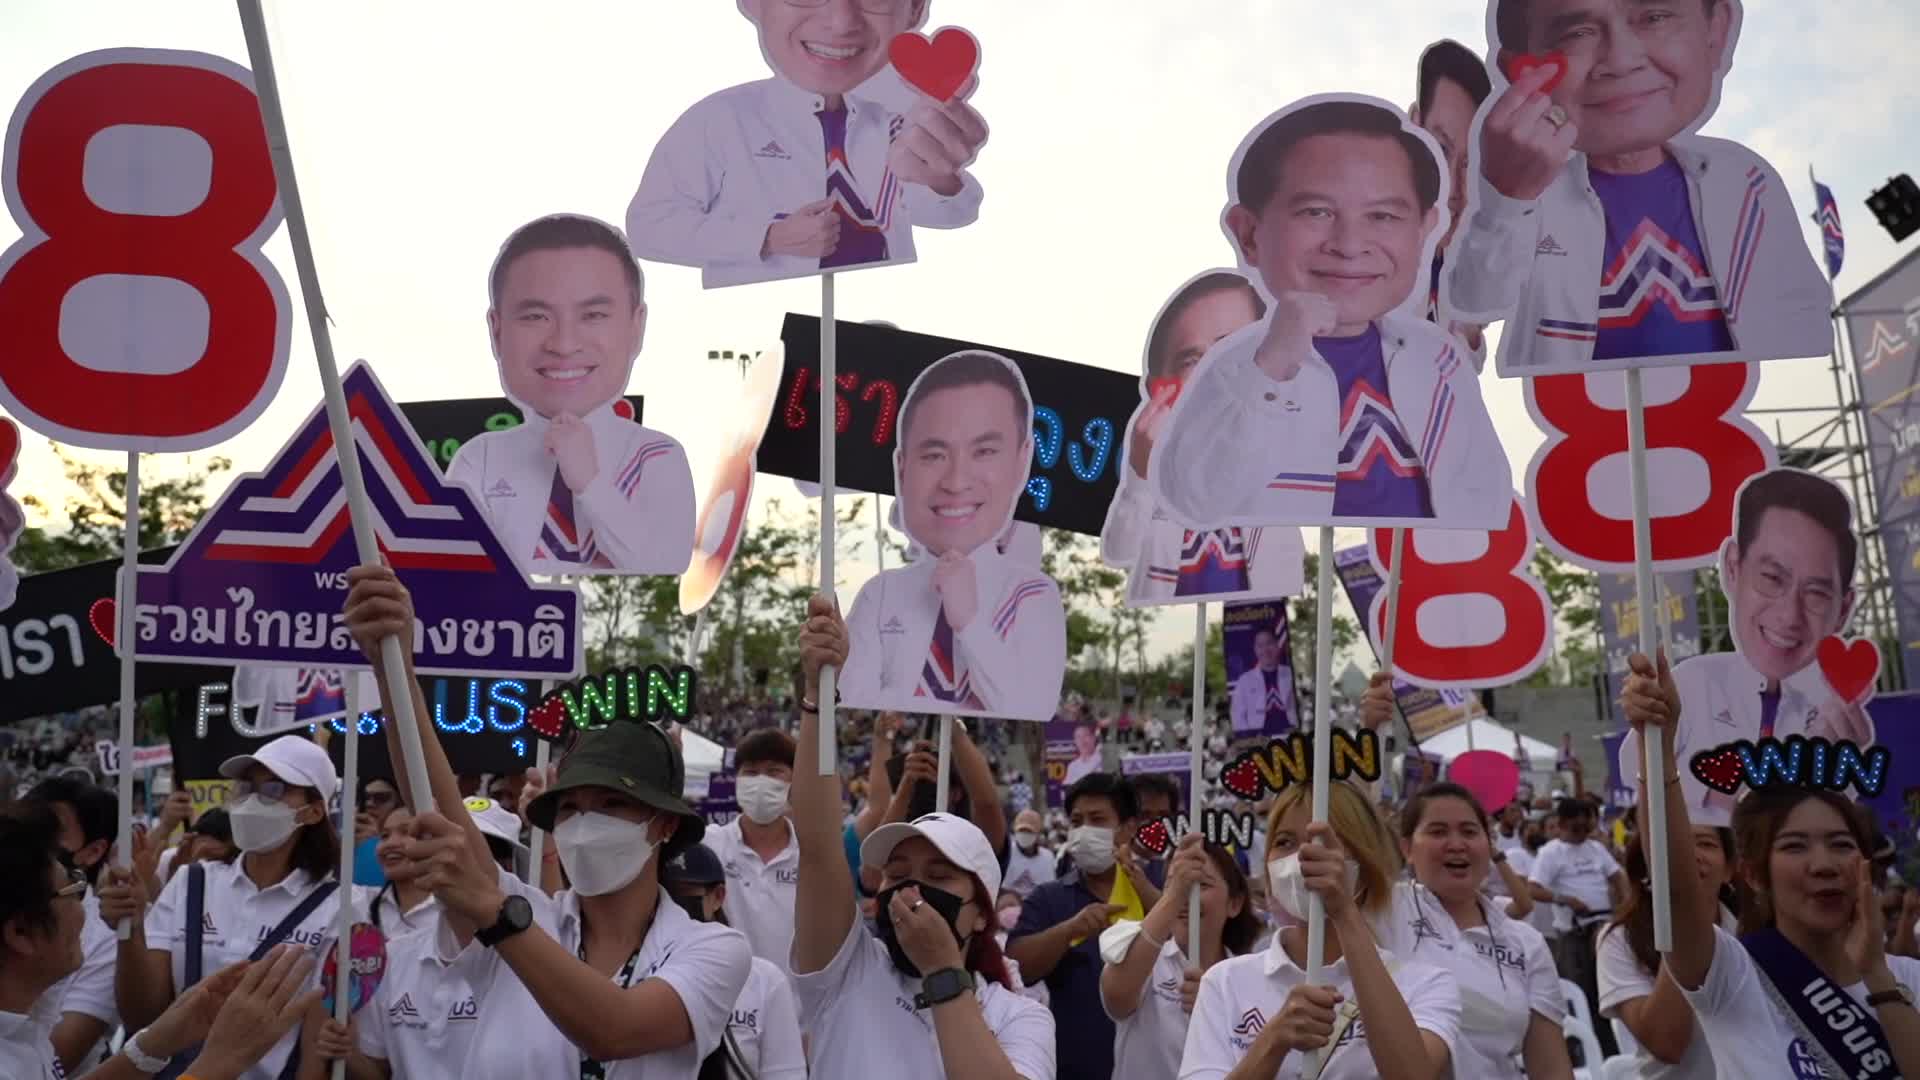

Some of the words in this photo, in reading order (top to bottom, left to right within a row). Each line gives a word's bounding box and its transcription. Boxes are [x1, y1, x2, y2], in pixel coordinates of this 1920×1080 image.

[0, 62, 277, 437] 8
[1533, 361, 1767, 563] 8
[313, 571, 349, 591] พร
[1374, 498, 1548, 682] 8
[136, 586, 566, 660] รวมไทยสางชาติ
[561, 669, 690, 731] WIN
[1251, 731, 1378, 792] WN
[1737, 740, 1885, 794] WIN
[1162, 811, 1252, 848] WIN
[1803, 976, 1894, 1080] เนวินธุ
